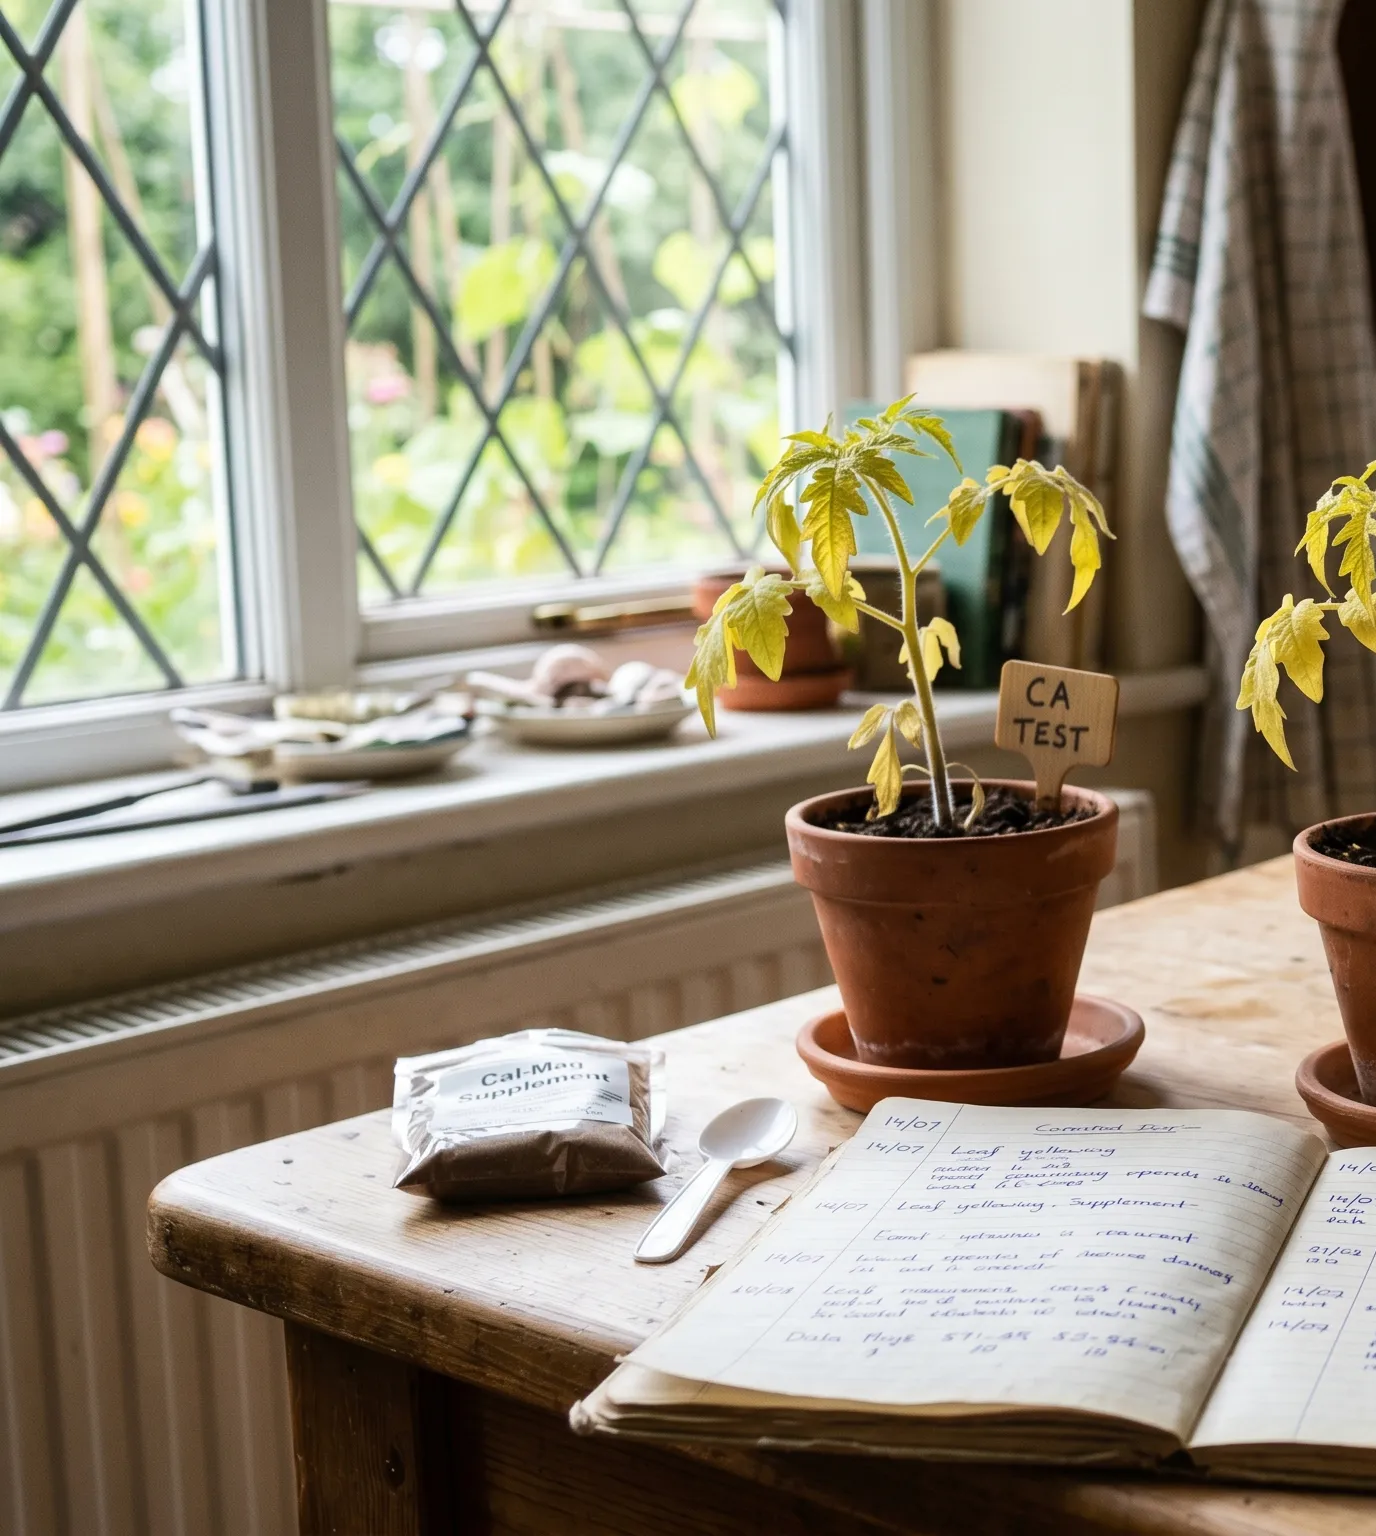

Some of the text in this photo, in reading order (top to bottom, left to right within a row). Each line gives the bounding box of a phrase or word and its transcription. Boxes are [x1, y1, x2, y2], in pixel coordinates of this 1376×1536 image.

[1026, 677, 1070, 711] CA
[1012, 717, 1090, 752] TEST
[458, 1072, 611, 1104] Supplement
[480, 1061, 584, 1088] Cal-Mag
[885, 1116, 942, 1131] 14/07
[866, 1141, 925, 1154] 14/07
